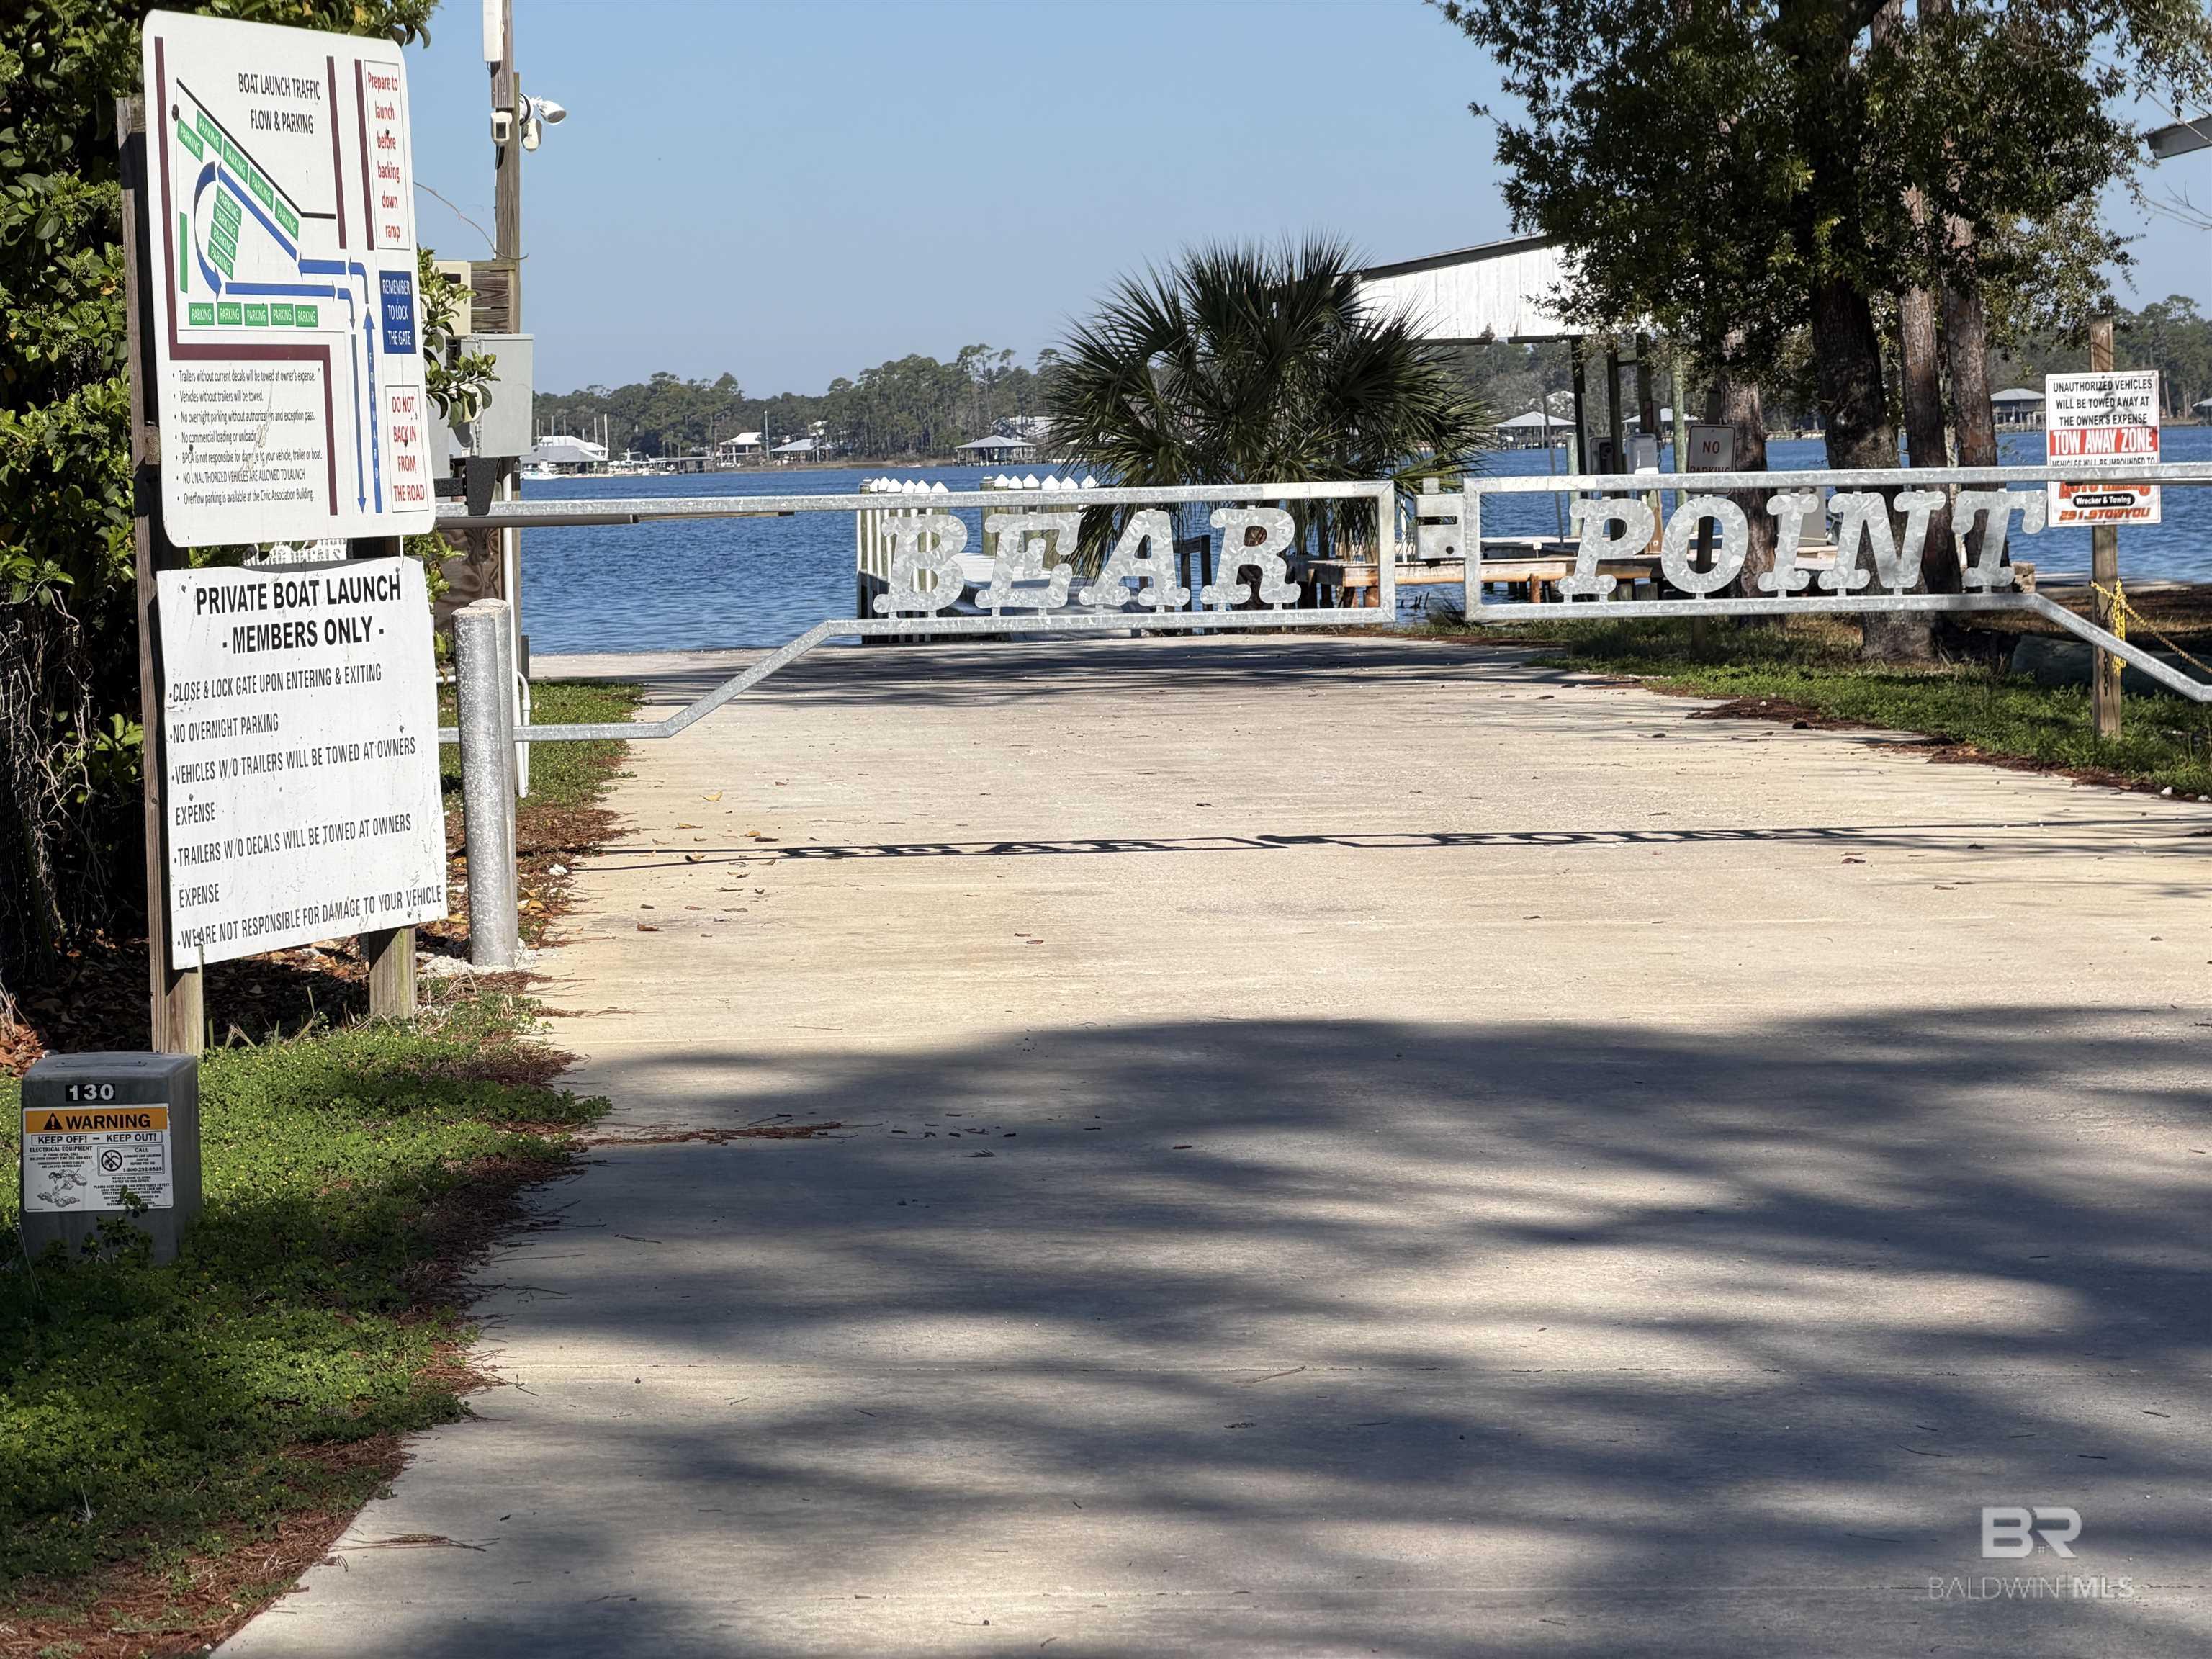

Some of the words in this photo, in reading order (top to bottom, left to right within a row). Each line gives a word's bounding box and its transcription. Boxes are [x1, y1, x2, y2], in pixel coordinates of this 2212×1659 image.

[238, 72, 259, 94] BOAT
[260, 74, 290, 98] LAUNCH
[291, 76, 320, 101] TRAFFIC
[368, 71, 390, 93] Prepare
[391, 76, 399, 91] to
[375, 102, 395, 121] launch
[251, 109, 273, 131] FLOW
[274, 112, 281, 132] &
[282, 112, 314, 135] PARKING
[180, 125, 201, 156] PARKING
[199, 118, 219, 148] PARKING
[377, 131, 396, 150] before
[226, 147, 246, 177] PARKING
[377, 161, 400, 183] backing
[252, 176, 271, 204] PARKING
[382, 190, 399, 209] down
[219, 191, 239, 220] PARKING
[216, 208, 236, 238] PARKING
[278, 204, 296, 234] PARKING
[385, 224, 400, 240] ramp
[213, 228, 233, 256] PARKING
[211, 246, 230, 274] PARKING
[382, 279, 410, 295] REMEMBER
[192, 308, 212, 322] PARKING
[220, 307, 239, 320] PARKING
[246, 310, 266, 322] PARKING
[273, 309, 292, 321] PARKING
[298, 311, 315, 323] PARKING
[387, 305, 395, 320] TO
[396, 305, 409, 320] LOCK
[387, 331, 397, 345] THE
[399, 331, 412, 346] GATE
[179, 369, 196, 382] Trailers
[197, 369, 214, 382] without
[215, 370, 230, 382] current
[232, 369, 245, 382] decals
[255, 369, 260, 382] be
[261, 369, 274, 382] towed
[275, 370, 279, 382] at
[281, 369, 297, 382] owner's
[297, 372, 315, 385] expense.
[2053, 379, 2113, 392] UNAUTHORIZED
[2114, 378, 2152, 390] VEHICLES
[180, 389, 199, 403] Vehicles
[199, 389, 217, 402] without
[217, 389, 233, 402] trailers
[242, 389, 248, 402] be
[249, 389, 264, 402] towed.
[392, 396, 401, 413] DO
[403, 396, 415, 413] NOT
[2056, 398, 2074, 410] WILL
[2077, 397, 2087, 408] BE
[2088, 397, 2115, 408] TOWED
[2117, 396, 2139, 408] AWAY
[2140, 396, 2149, 406] AT
[2059, 416, 2074, 426] THE
[2077, 415, 2111, 426] OWNER'S
[2113, 413, 2147, 425] EXPENSE
[393, 426, 408, 442] BACK
[410, 426, 416, 442] IN
[2053, 430, 2081, 455] TOW
[2085, 428, 2117, 454] AWAY
[2121, 428, 2154, 452] ZONE
[1702, 441, 1720, 454] NO
[397, 455, 416, 472] FROM
[183, 472, 190, 484] NO
[192, 471, 228, 484] UNAUTHORIZED
[228, 470, 248, 482] VEHICLES
[249, 469, 258, 482] ARE
[259, 469, 279, 481] ALLOWED
[281, 469, 287, 481] TO
[288, 468, 305, 480] LAUNCH
[184, 491, 204, 505] Overflow
[204, 491, 222, 506] parking
[222, 491, 226, 503] is
[227, 490, 246, 503] available
[248, 490, 252, 502] at
[261, 489, 271, 501] Civic
[271, 488, 295, 501] Association
[296, 487, 314, 502] Building.
[393, 485, 406, 501] THE
[408, 484, 425, 501] ROAD
[2108, 495, 2131, 505] Towing
[1558, 490, 2047, 596] POINT
[873, 507, 1301, 613] BEAR
[196, 583, 268, 615] PRIVATE
[274, 580, 320, 610] BOAT
[326, 575, 401, 605] LAUNCH
[233, 619, 318, 654] MEMBERS
[324, 616, 373, 646] ONLY
[173, 680, 201, 703] CLOSE
[203, 680, 210, 698] &
[212, 678, 233, 698] LOCK
[236, 676, 257, 695] GATE
[260, 673, 284, 693] UPON
[287, 667, 331, 691] ENTERING
[336, 667, 341, 685] &
[344, 663, 382, 684] EXITING
[173, 724, 185, 743] NO
[189, 718, 238, 742] OVERNIGHT
[240, 713, 279, 735] PARKING
[175, 762, 215, 785] VEHICLES
[240, 752, 283, 775] TRAILERS
[285, 750, 308, 770] WILL
[312, 748, 323, 768] BE
[325, 743, 360, 764] TOWED
[363, 742, 375, 760] AT
[377, 737, 416, 757] OWNERS
[176, 802, 216, 826] EXPENSE
[177, 843, 221, 867] TRAILERS
[246, 833, 280, 855] DECALS
[283, 830, 305, 852] WILL
[309, 828, 320, 846] BE
[323, 822, 356, 845] TOWED
[359, 819, 371, 838] AT
[373, 813, 412, 836] OWNERS
[179, 883, 220, 909] EXPENSE
[181, 929, 199, 949] WE
[200, 926, 217, 945] ARE
[219, 921, 239, 941] NOT
[242, 909, 300, 937] RESPONSIBLE
[302, 906, 320, 925] FOR
[323, 900, 360, 922] DAMAGE
[363, 897, 375, 915] TO
[379, 891, 403, 912] YOUR
[406, 884, 441, 908] VEHICLE
[69, 1084, 114, 1100] 130
[66, 1113, 150, 1130] WARNING
[66, 1135, 87, 1143] OFF!
[107, 1134, 131, 1143] KEEP
[135, 1133, 157, 1142] OUT!
